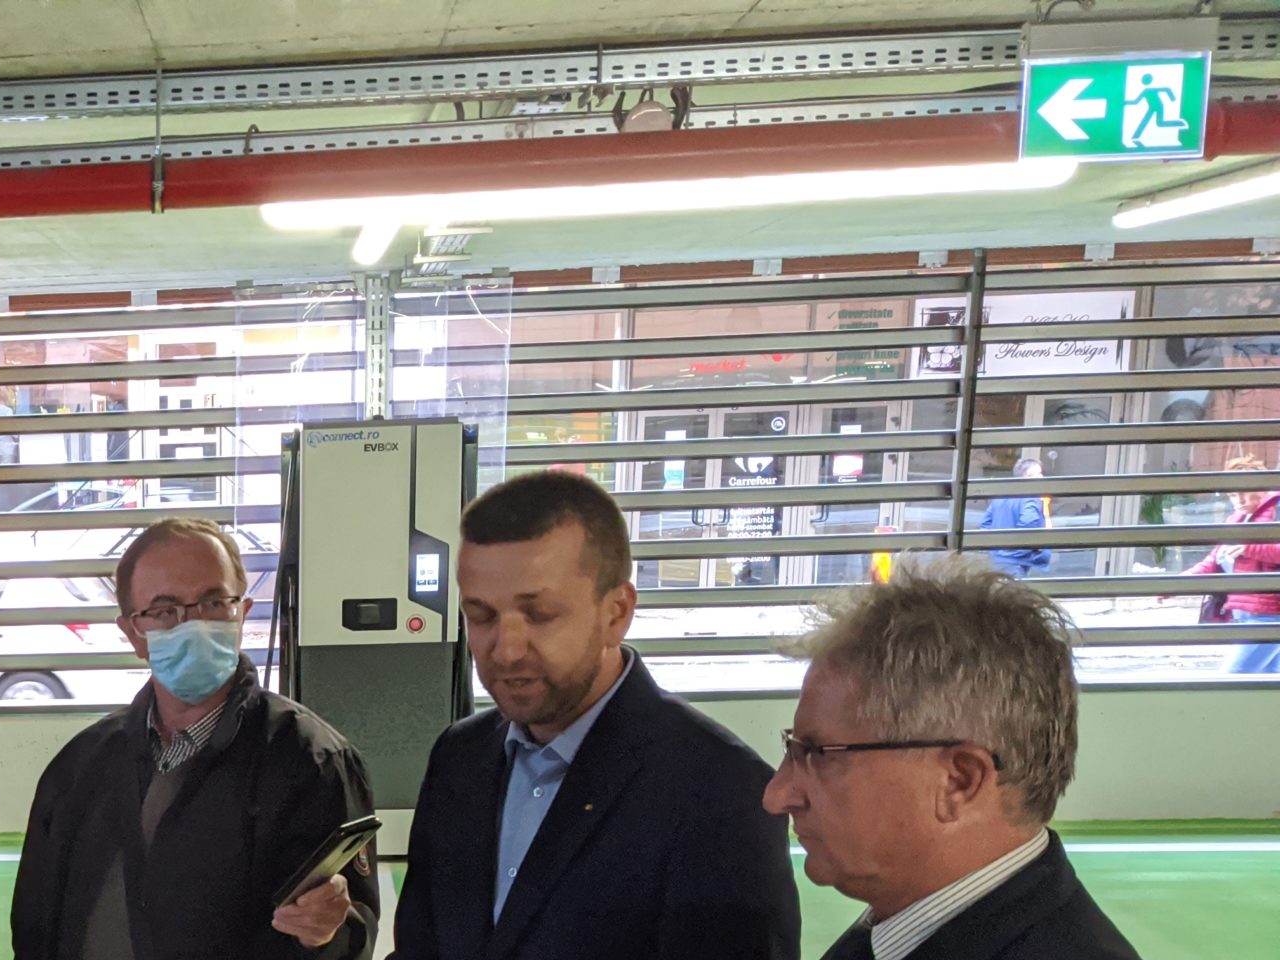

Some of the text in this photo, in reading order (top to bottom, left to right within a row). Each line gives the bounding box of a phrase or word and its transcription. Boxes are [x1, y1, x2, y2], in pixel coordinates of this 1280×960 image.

[994, 340, 1109, 363] Flowers Design
[363, 442, 399, 452] EVBOX
[729, 475, 778, 486] Carrefour
